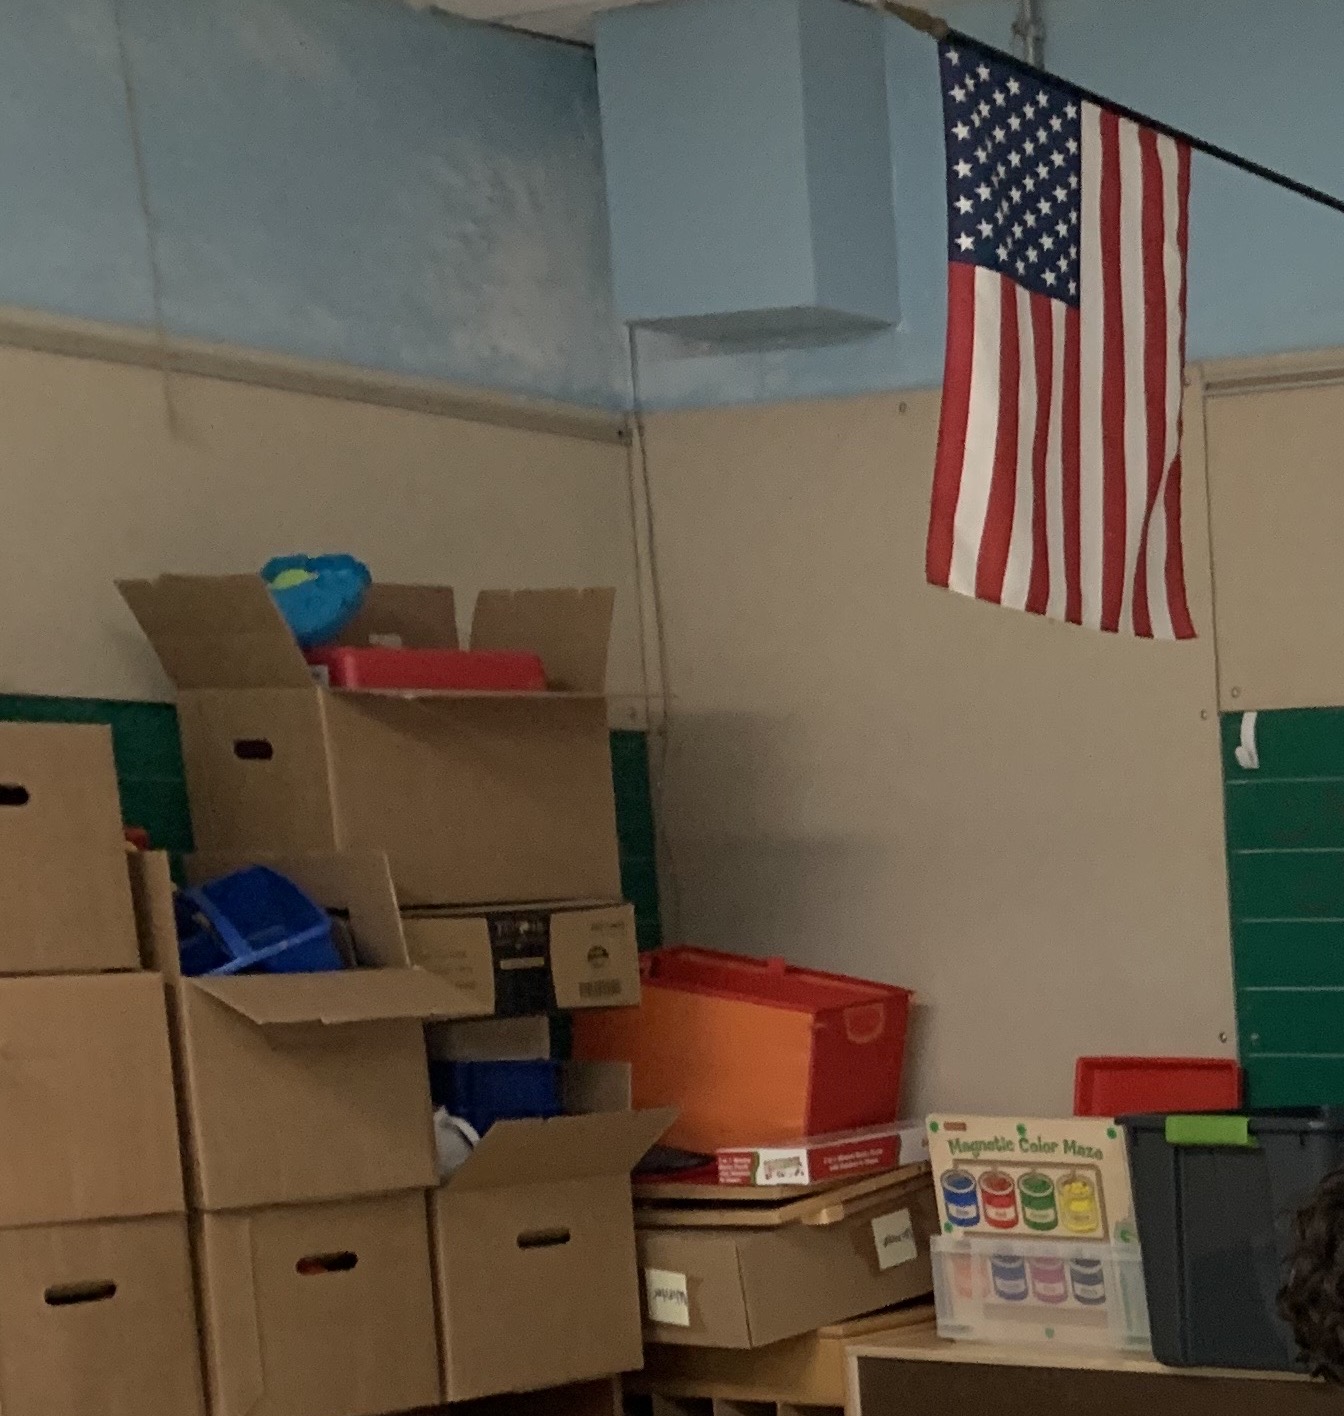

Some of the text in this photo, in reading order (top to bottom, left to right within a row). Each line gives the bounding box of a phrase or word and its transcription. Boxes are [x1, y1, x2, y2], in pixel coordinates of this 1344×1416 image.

[947, 1135, 1104, 1161] Magnetic Color Maze
